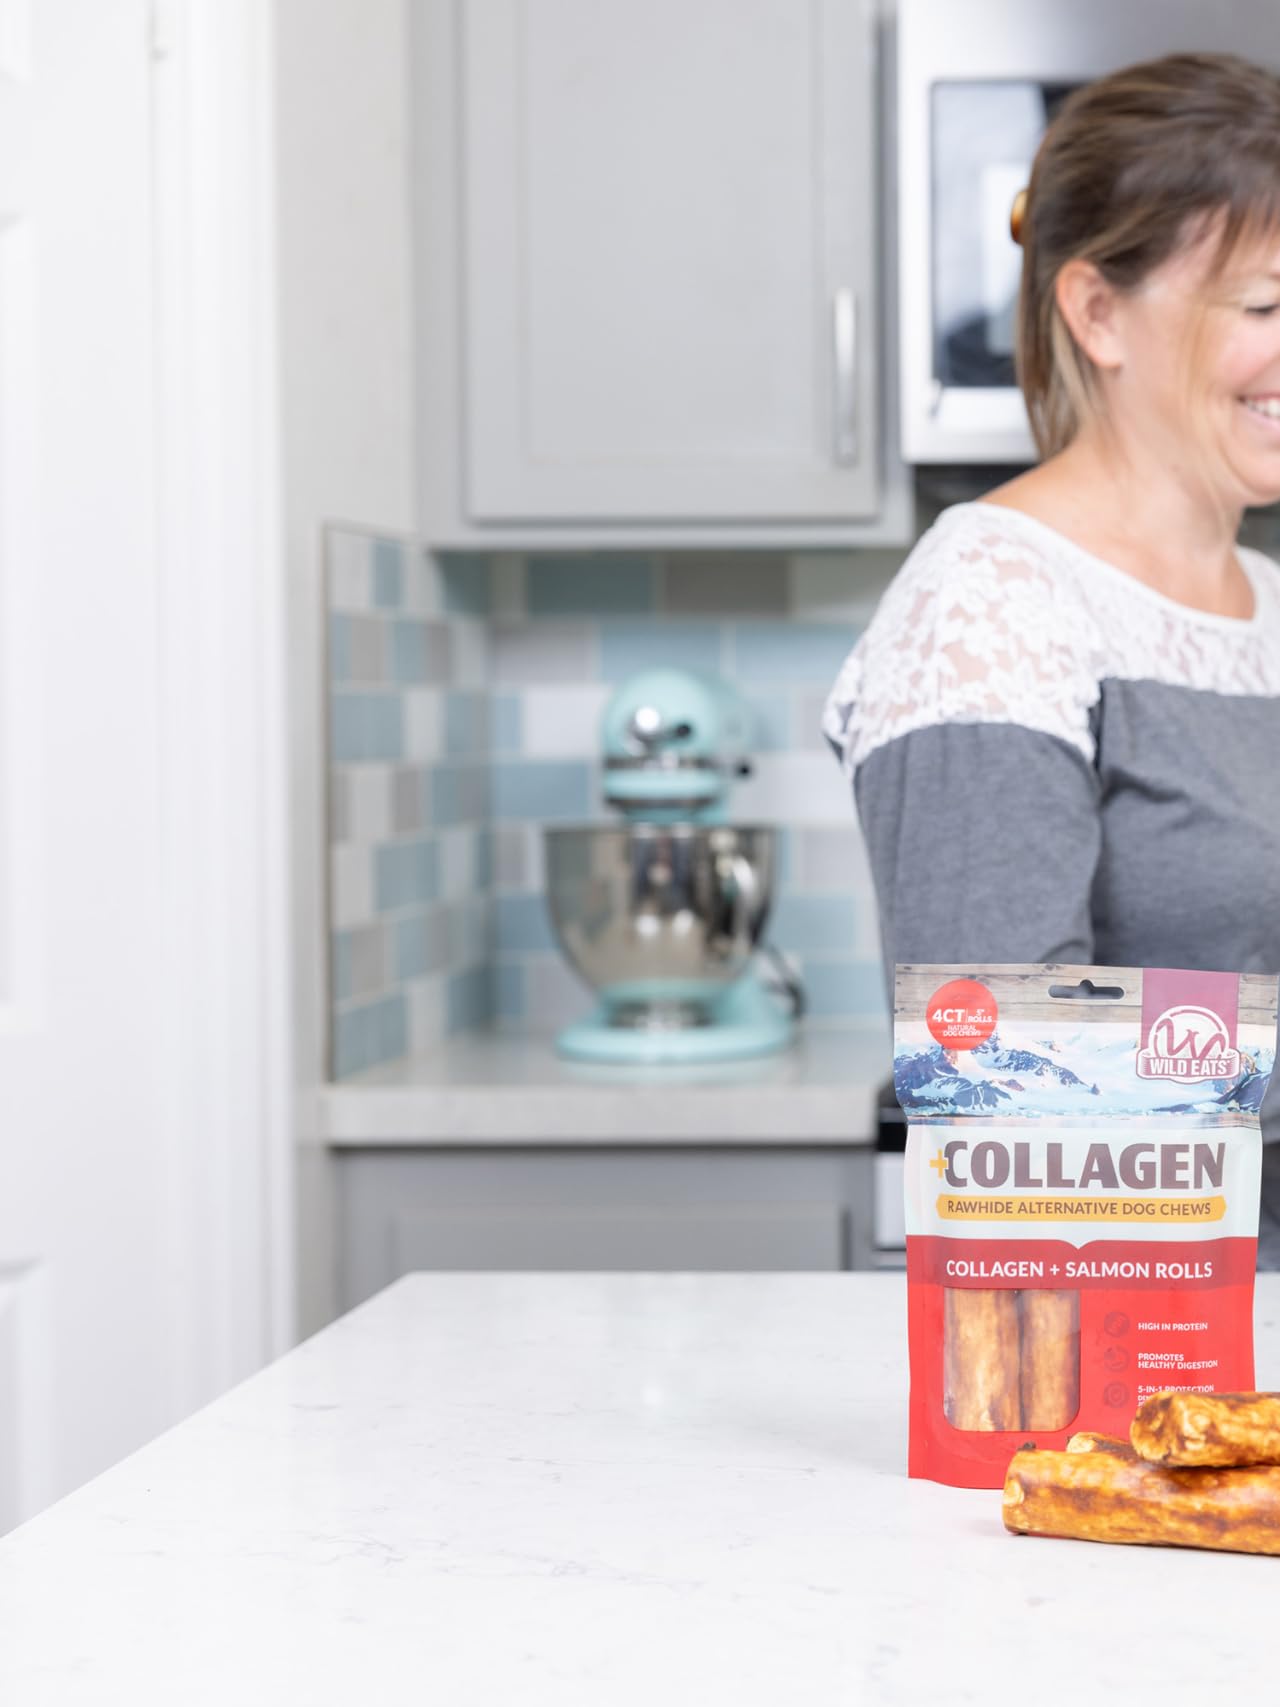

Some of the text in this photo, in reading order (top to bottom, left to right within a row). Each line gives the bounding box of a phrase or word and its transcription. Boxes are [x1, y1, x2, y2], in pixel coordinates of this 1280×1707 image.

[932, 1008, 965, 1023] 4CT
[968, 1015, 993, 1023] ROLLS
[1150, 1059, 1227, 1075] WILD EATS
[947, 1200, 1211, 1216] RAWHIDE ALTERNATIVE DOG CHEWS
[946, 1260, 1044, 1277] COLLAGEN
[1065, 1261, 1149, 1278] SALMON
[1155, 1262, 1213, 1279] ROLLS
[1138, 1322, 1160, 1330] HIGH
[1172, 1322, 1208, 1331] PROTEIN
[1138, 1353, 1184, 1361] PROMOTES
[1138, 1360, 1218, 1369] HEALTHY DIGESTION
[1138, 1384, 1214, 1393] 5-IN-1 PROTECTION
